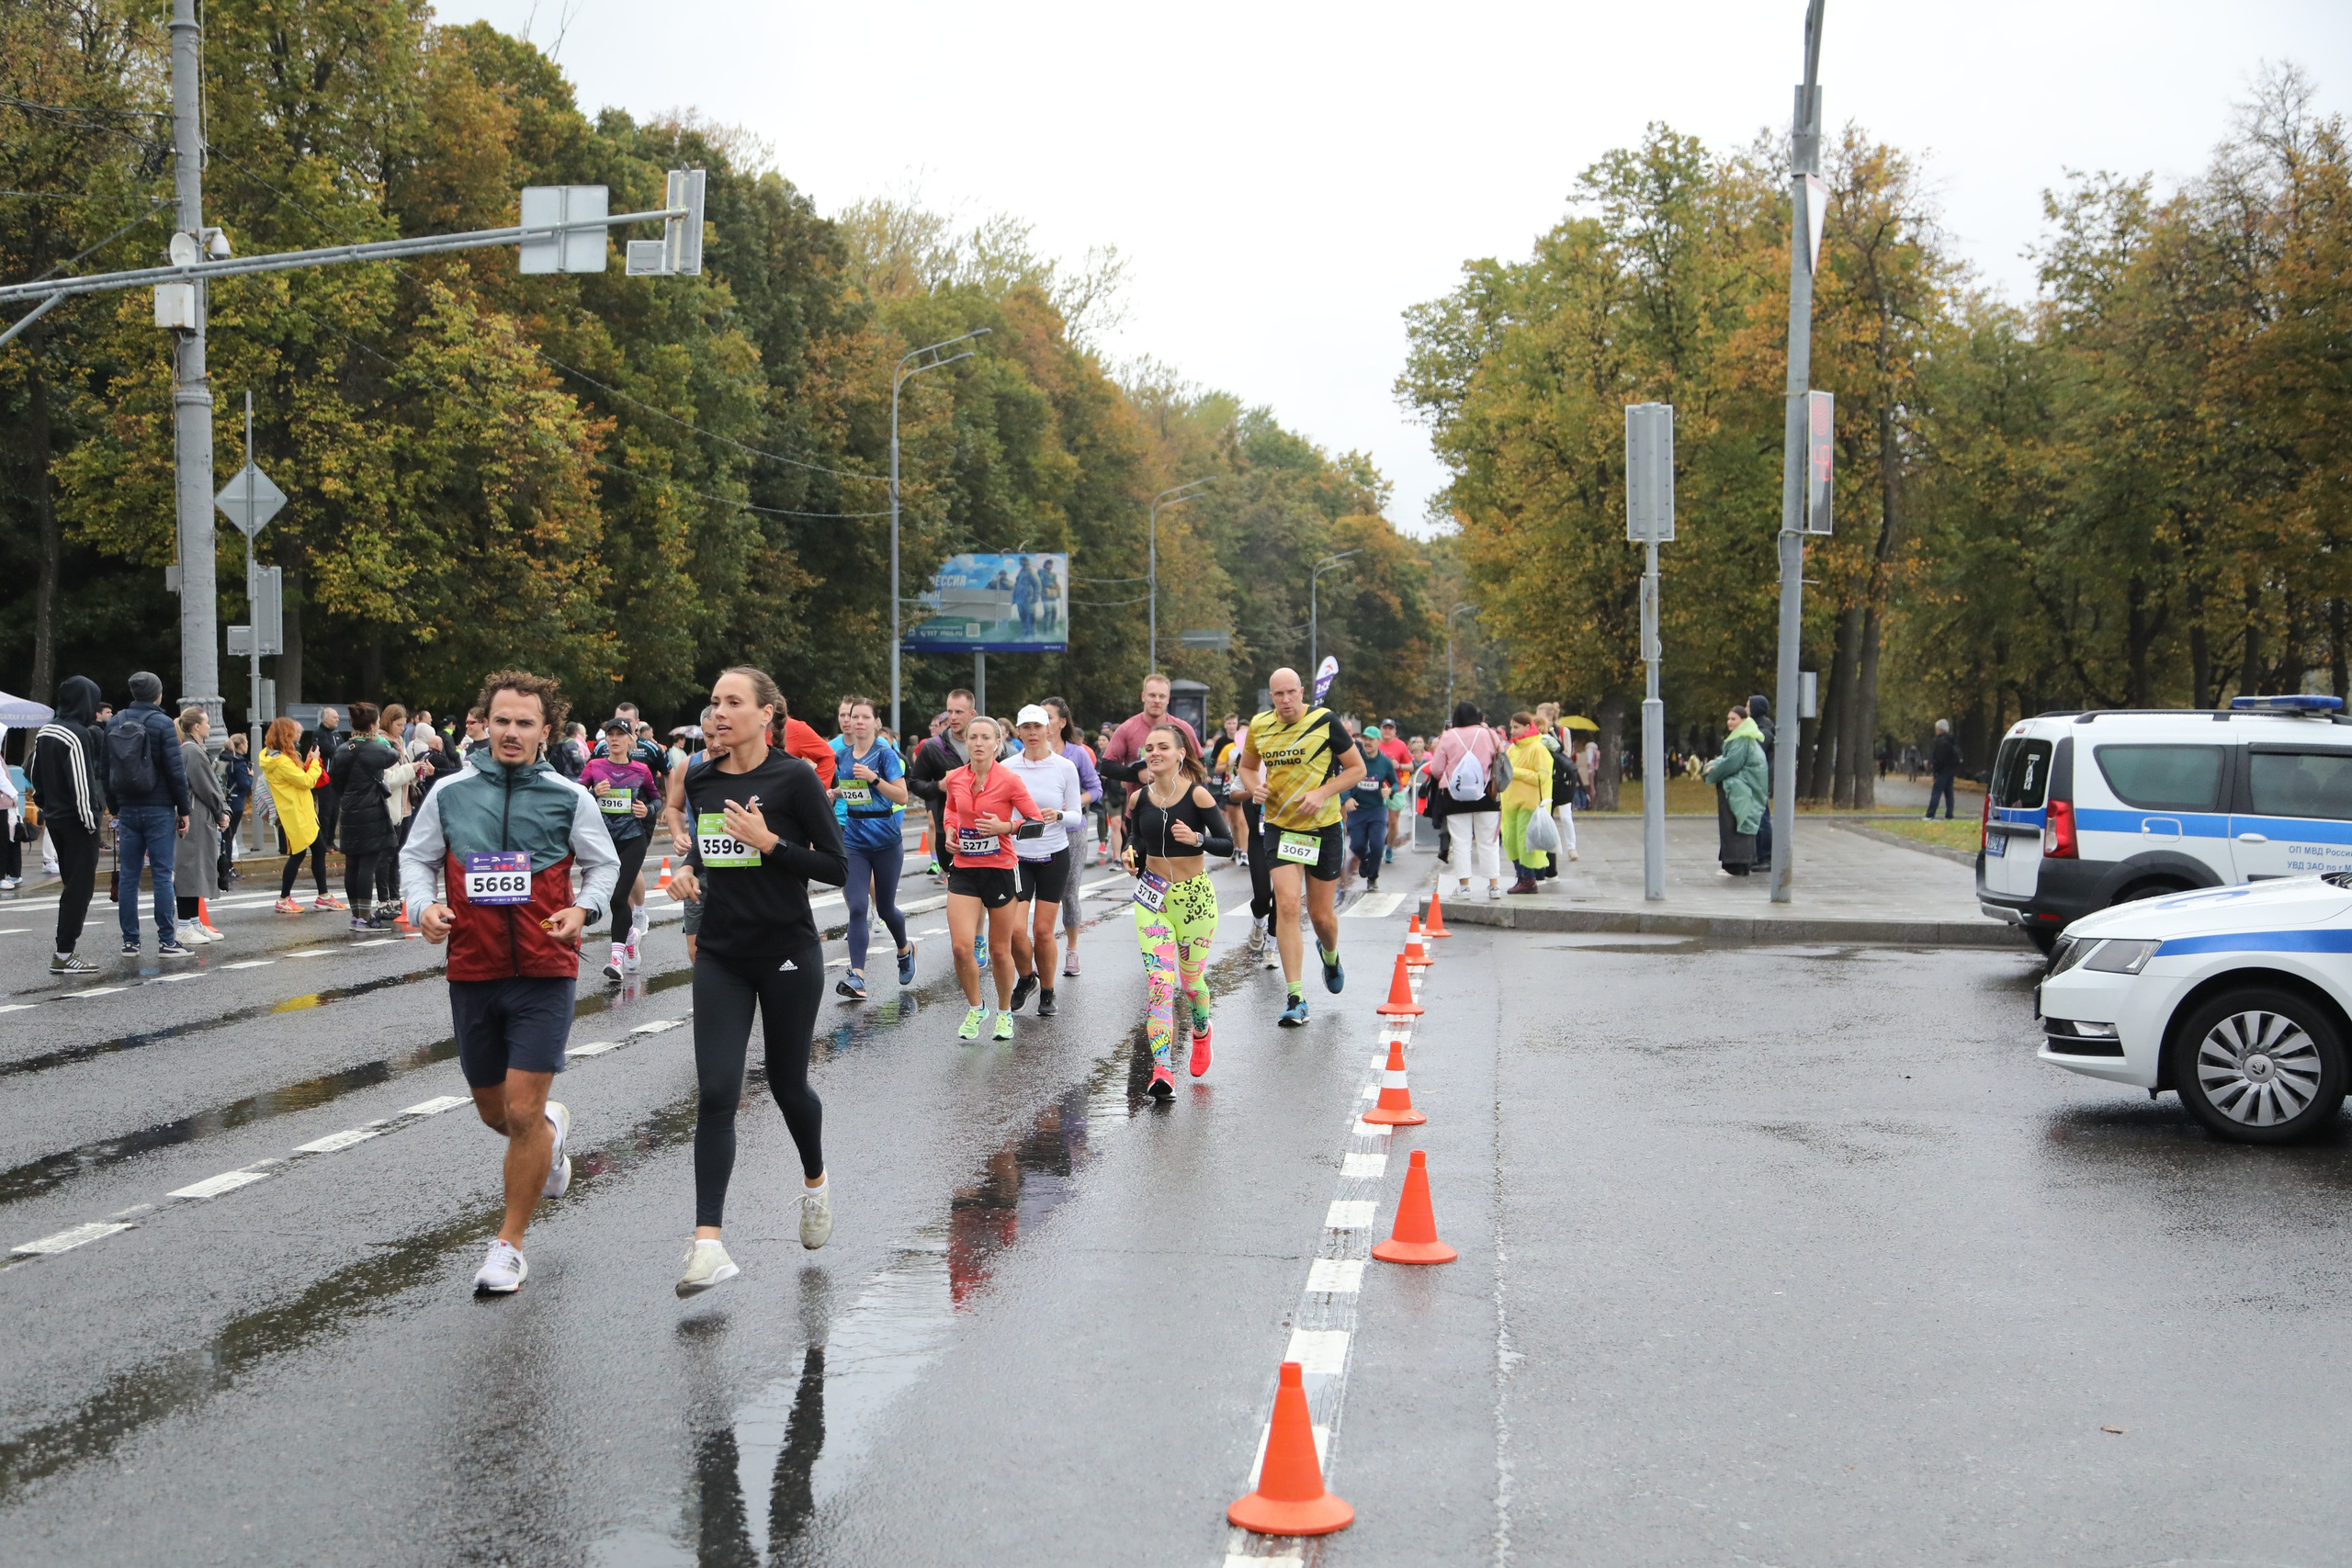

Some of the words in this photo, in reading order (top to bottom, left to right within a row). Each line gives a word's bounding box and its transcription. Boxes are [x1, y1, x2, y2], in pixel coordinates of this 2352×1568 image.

[601, 799, 623, 807] 3916
[703, 839, 745, 854] 3596
[963, 840, 989, 851] 5277
[1283, 844, 1312, 857] 3067
[2289, 845, 2301, 853] ОП
[2304, 846, 2324, 856] МВД
[2288, 861, 2304, 871] УВД
[2307, 862, 2324, 871] ЗАО
[473, 875, 526, 893] 5668
[1145, 926, 1169, 937] OMG!
